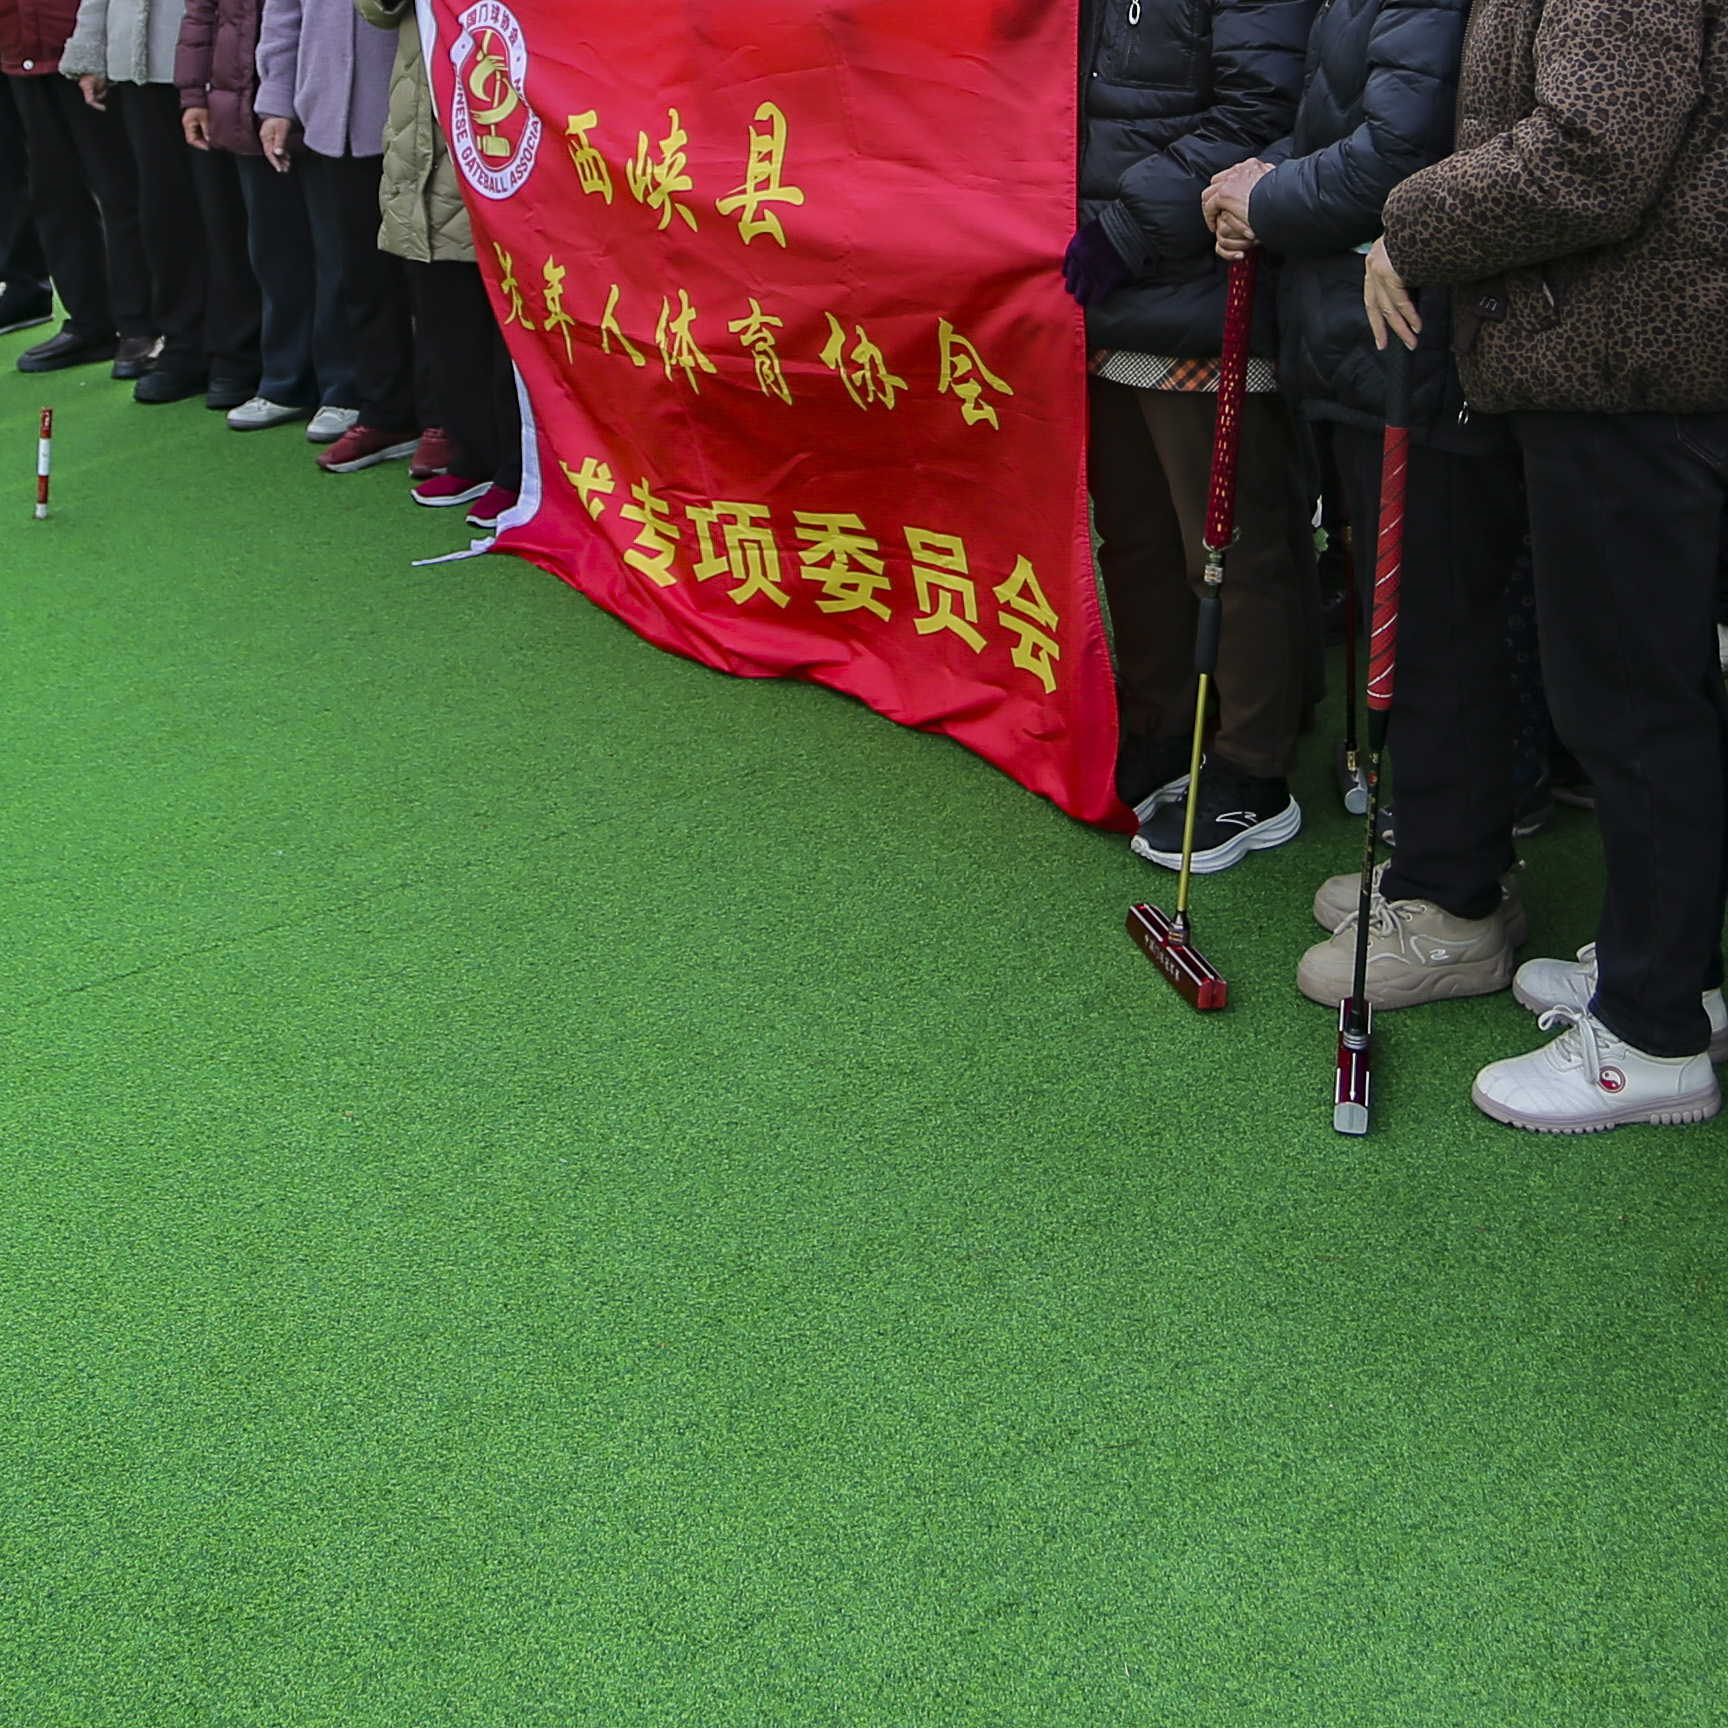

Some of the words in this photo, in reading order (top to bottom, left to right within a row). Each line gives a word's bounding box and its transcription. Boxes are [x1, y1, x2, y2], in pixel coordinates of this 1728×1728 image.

[460, 145, 509, 194] GATEBALL
[565, 100, 805, 249] 西峡县
